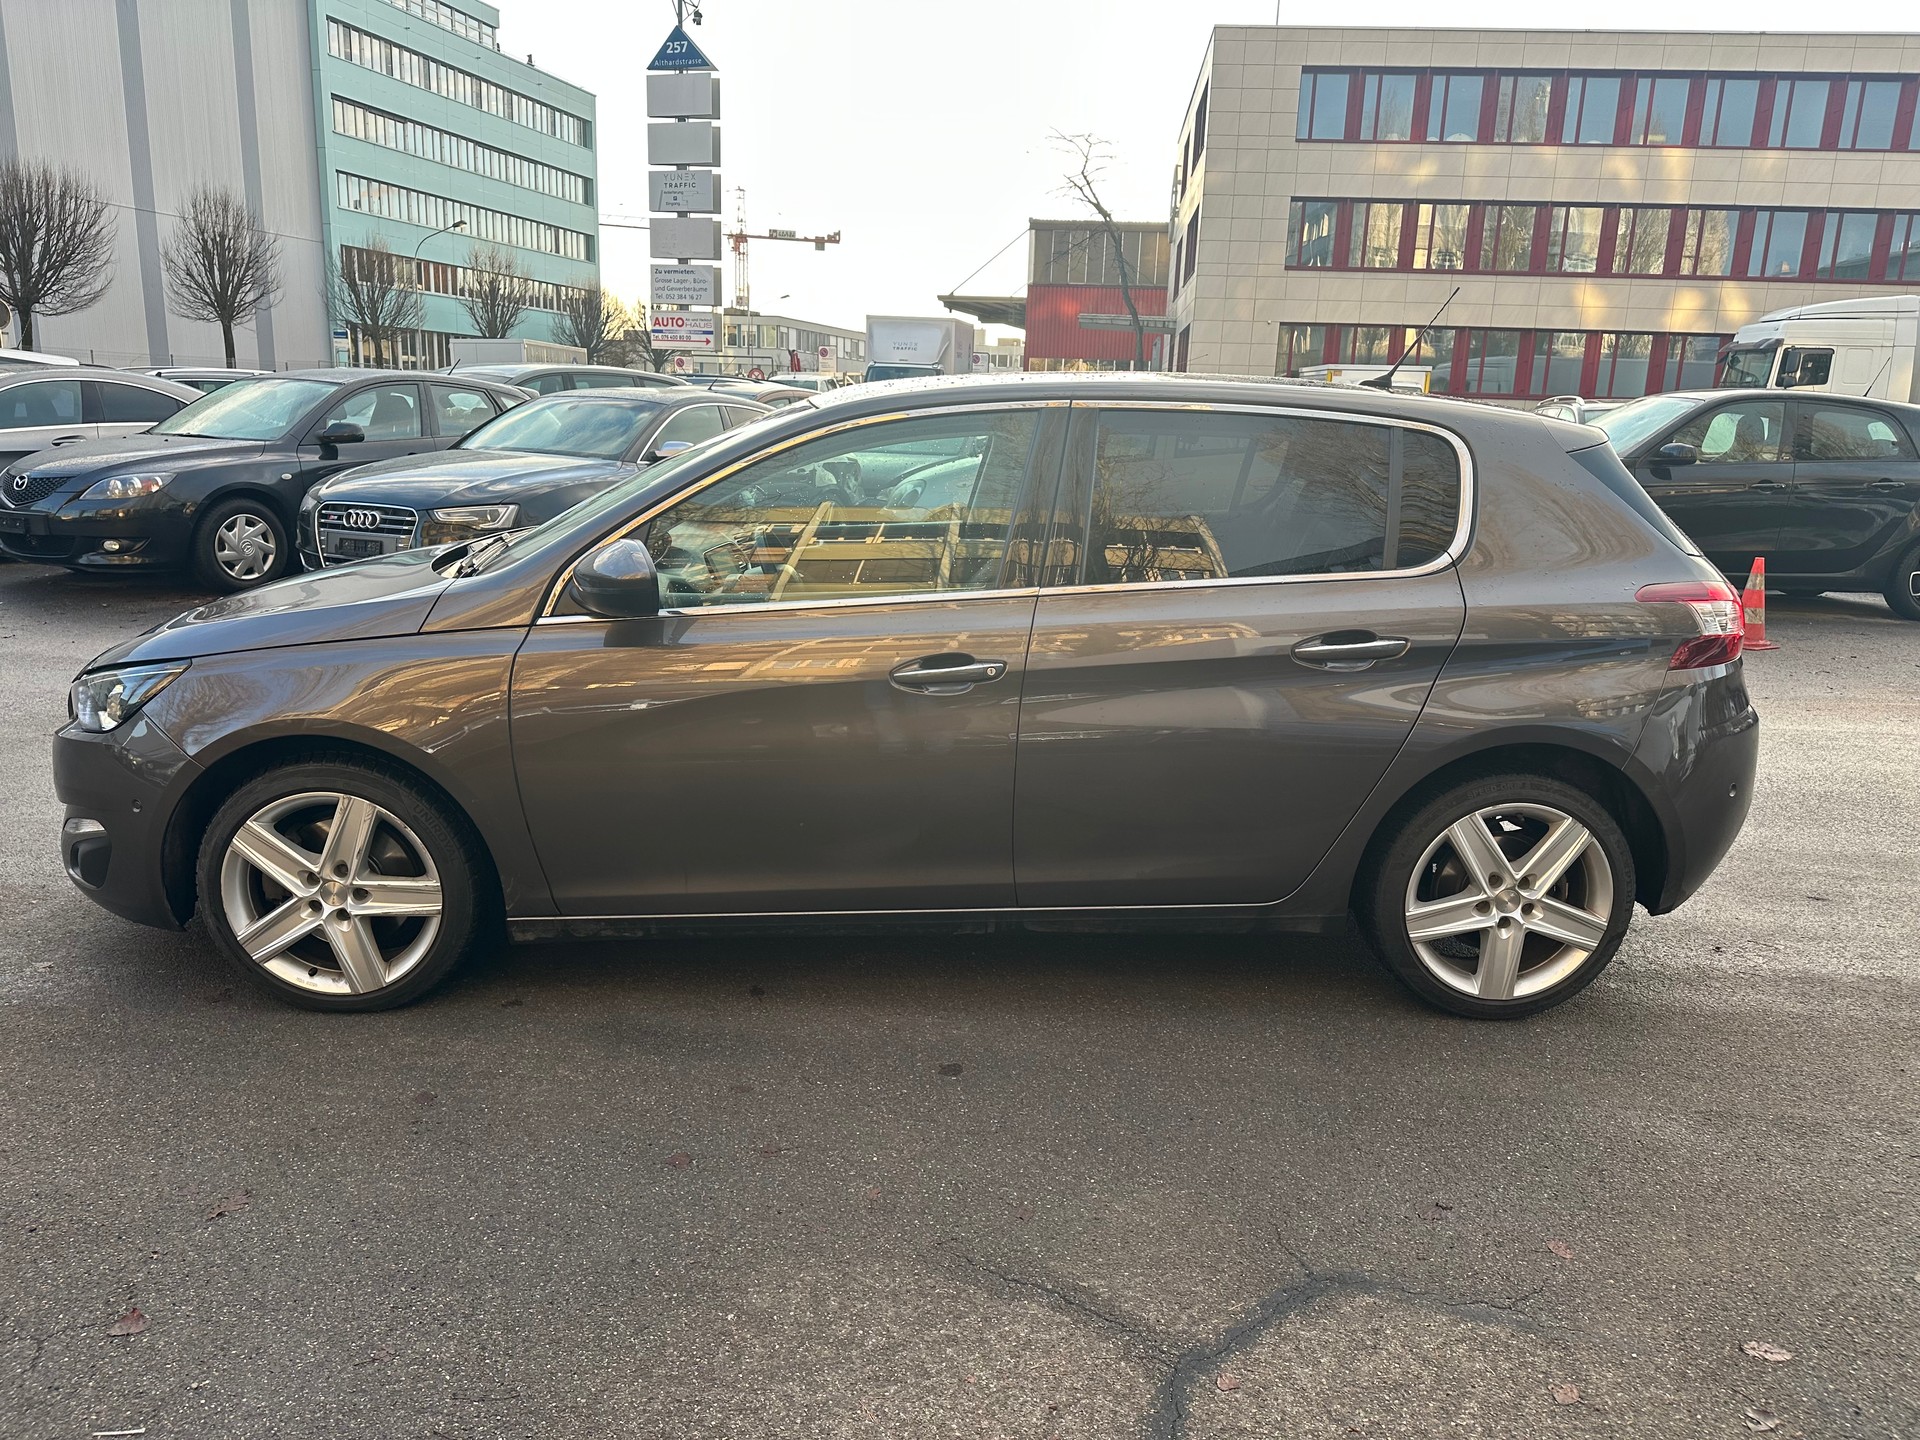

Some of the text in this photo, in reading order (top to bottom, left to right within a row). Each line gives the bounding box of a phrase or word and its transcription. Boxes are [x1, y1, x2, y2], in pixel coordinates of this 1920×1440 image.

[666, 41, 688, 54] 257
[654, 58, 702, 67] Althardstrasse
[663, 172, 697, 181] YUNEX
[653, 316, 685, 328] AUTO
[413, 803, 457, 865] UNIROYAL
